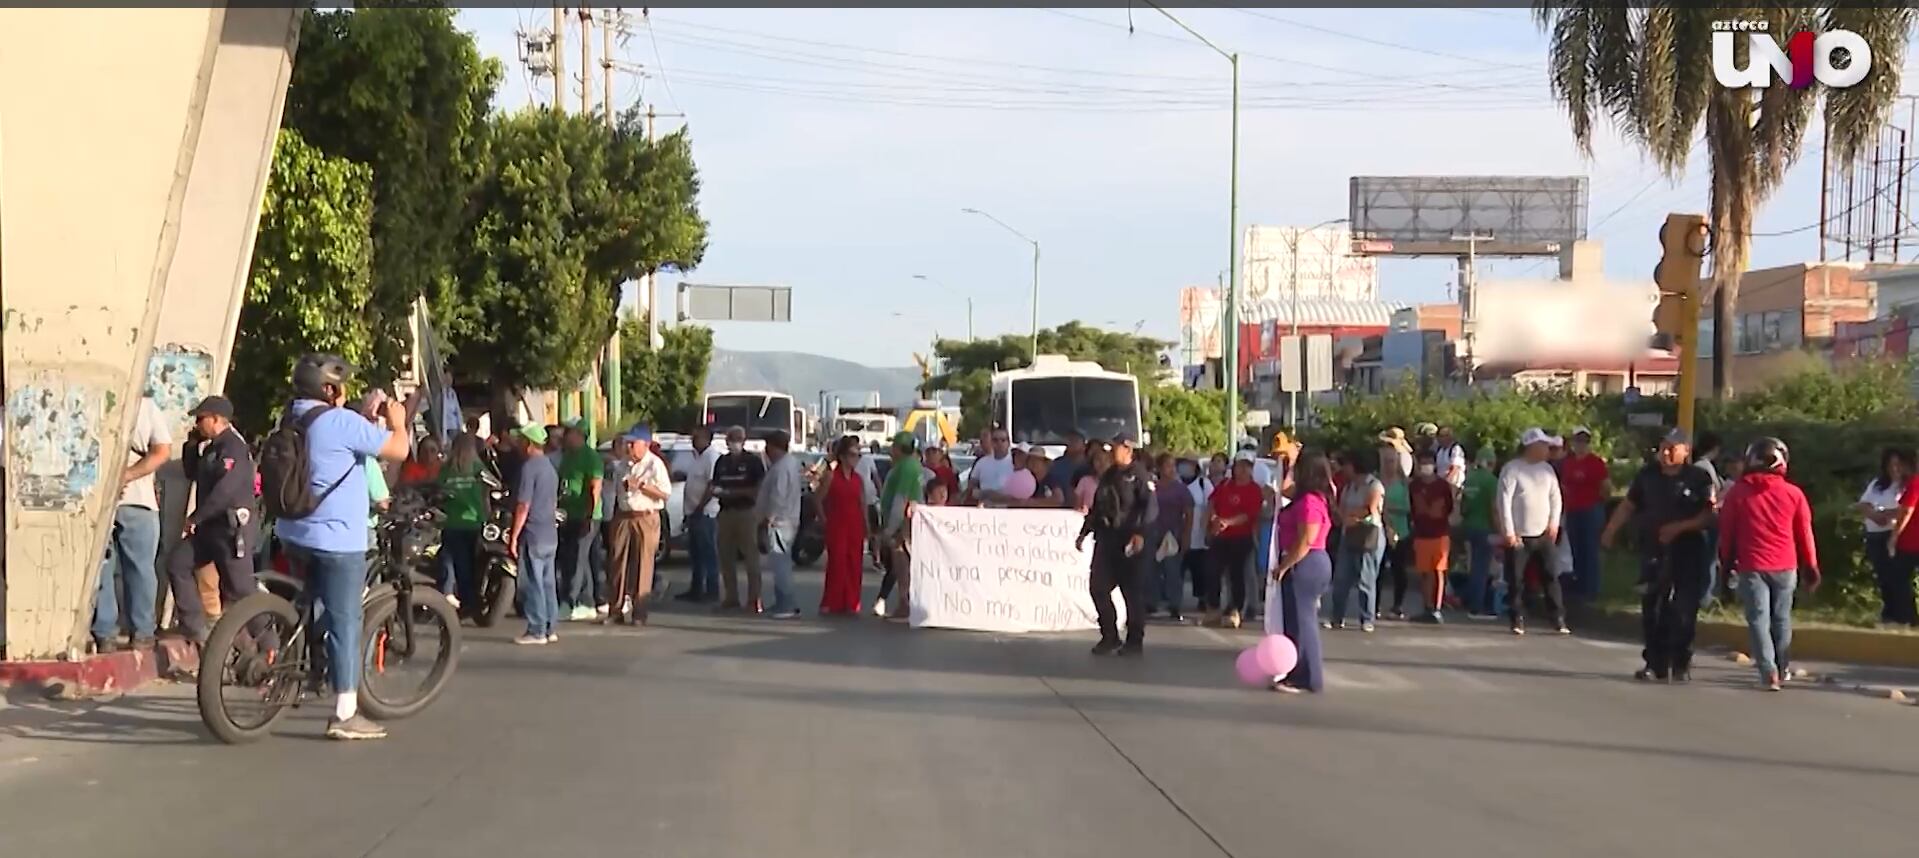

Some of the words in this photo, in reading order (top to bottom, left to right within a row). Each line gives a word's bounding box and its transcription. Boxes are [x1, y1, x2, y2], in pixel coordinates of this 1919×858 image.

[920, 510, 1008, 536] Pesidente
[920, 560, 941, 581] Ni
[949, 564, 981, 583] una
[998, 566, 1053, 588] persona
[943, 591, 972, 615] No
